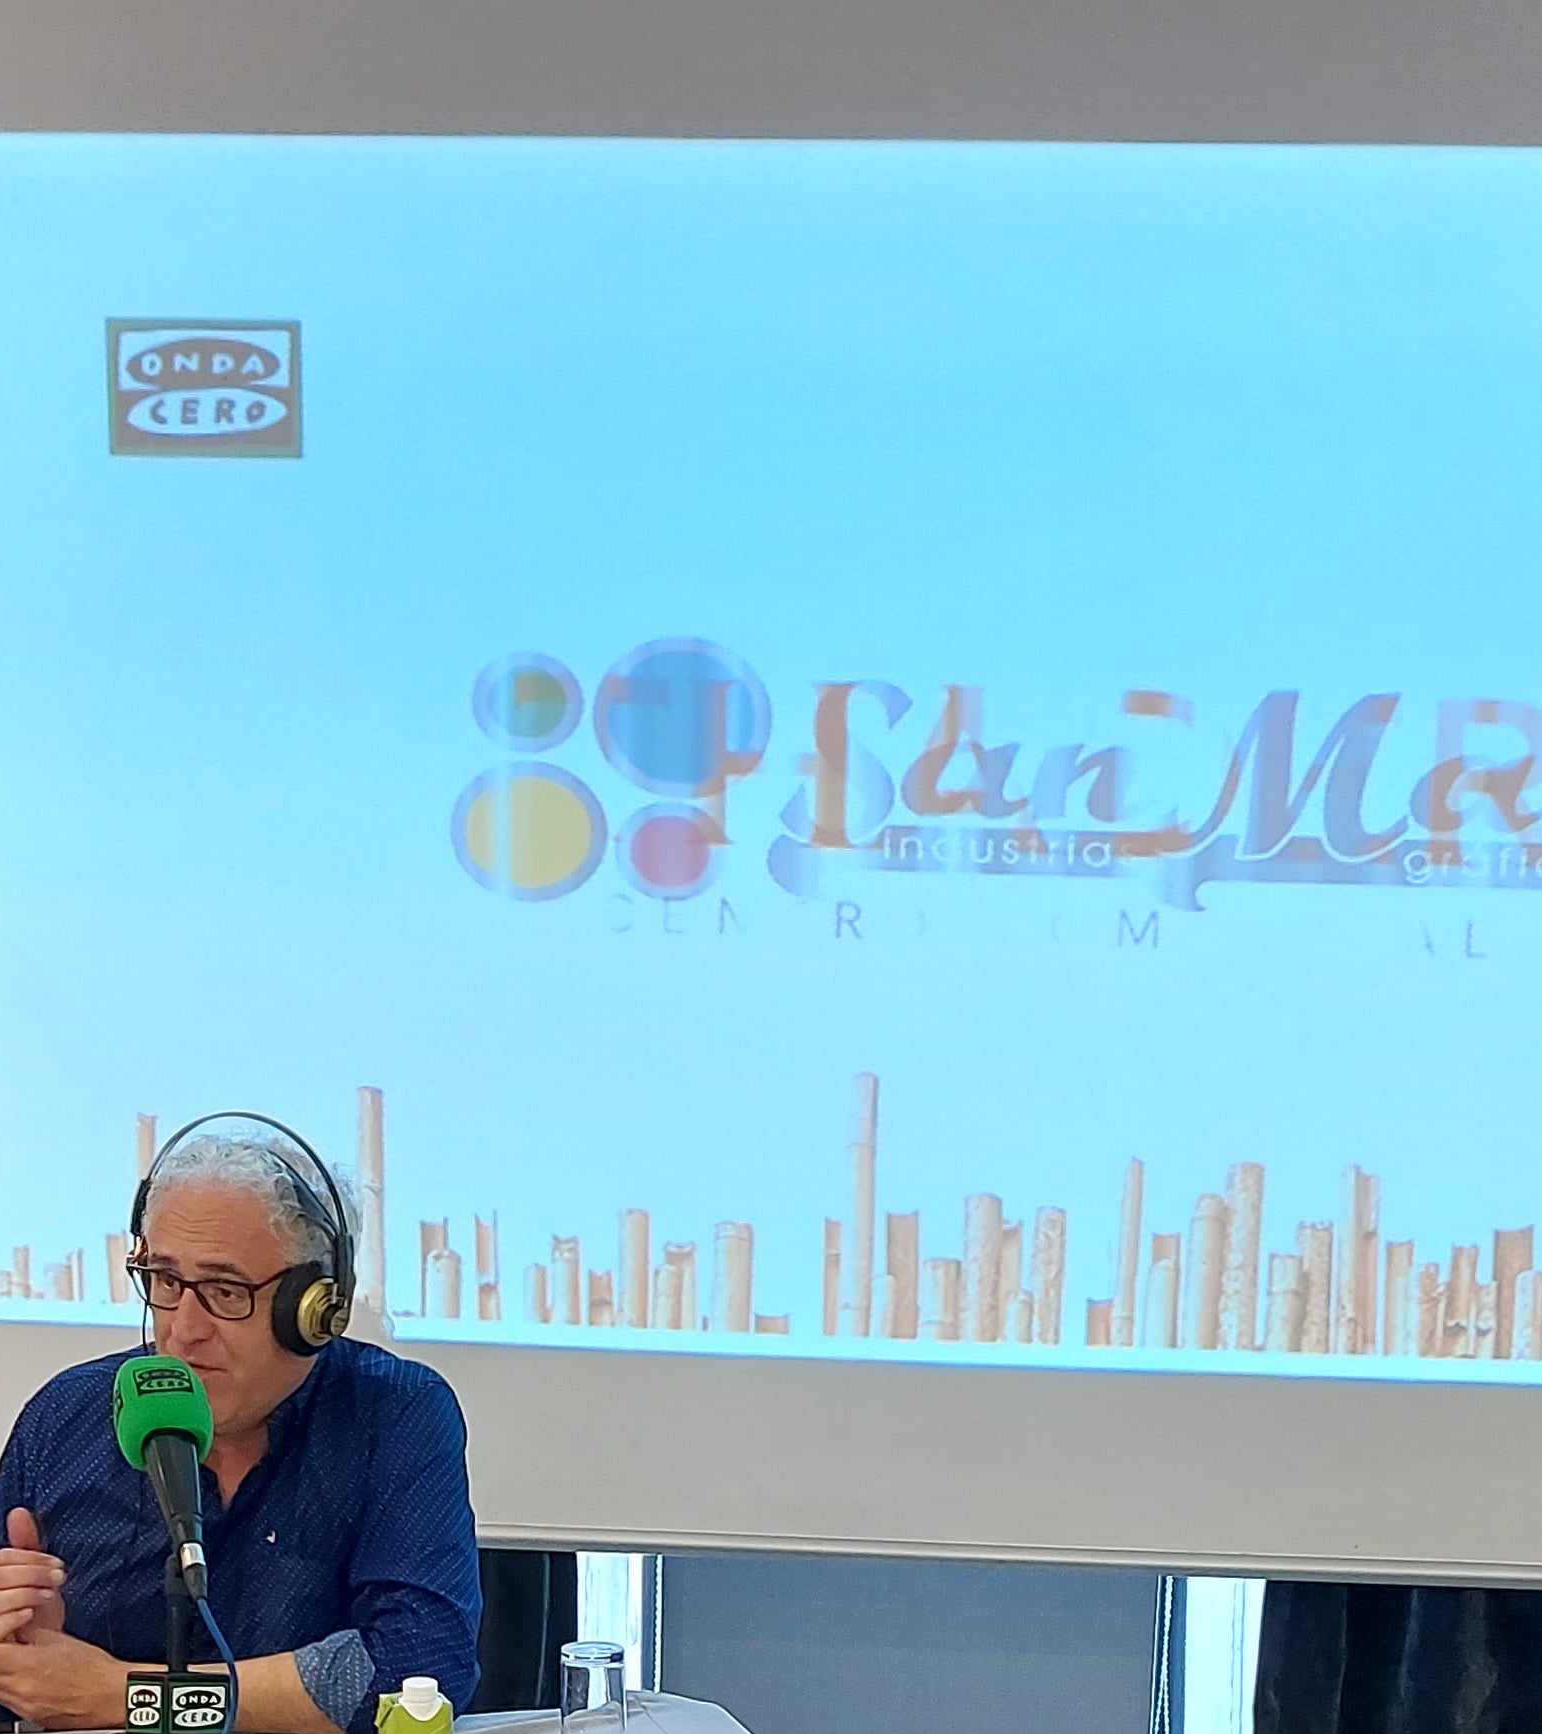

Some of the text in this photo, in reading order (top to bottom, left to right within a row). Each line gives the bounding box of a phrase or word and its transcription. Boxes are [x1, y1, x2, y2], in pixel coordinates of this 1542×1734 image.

[141, 352, 265, 376] ONDA
[150, 397, 267, 425] CERO
[179, 1695, 218, 1705] ONDA
[181, 1712, 218, 1723] CERO
